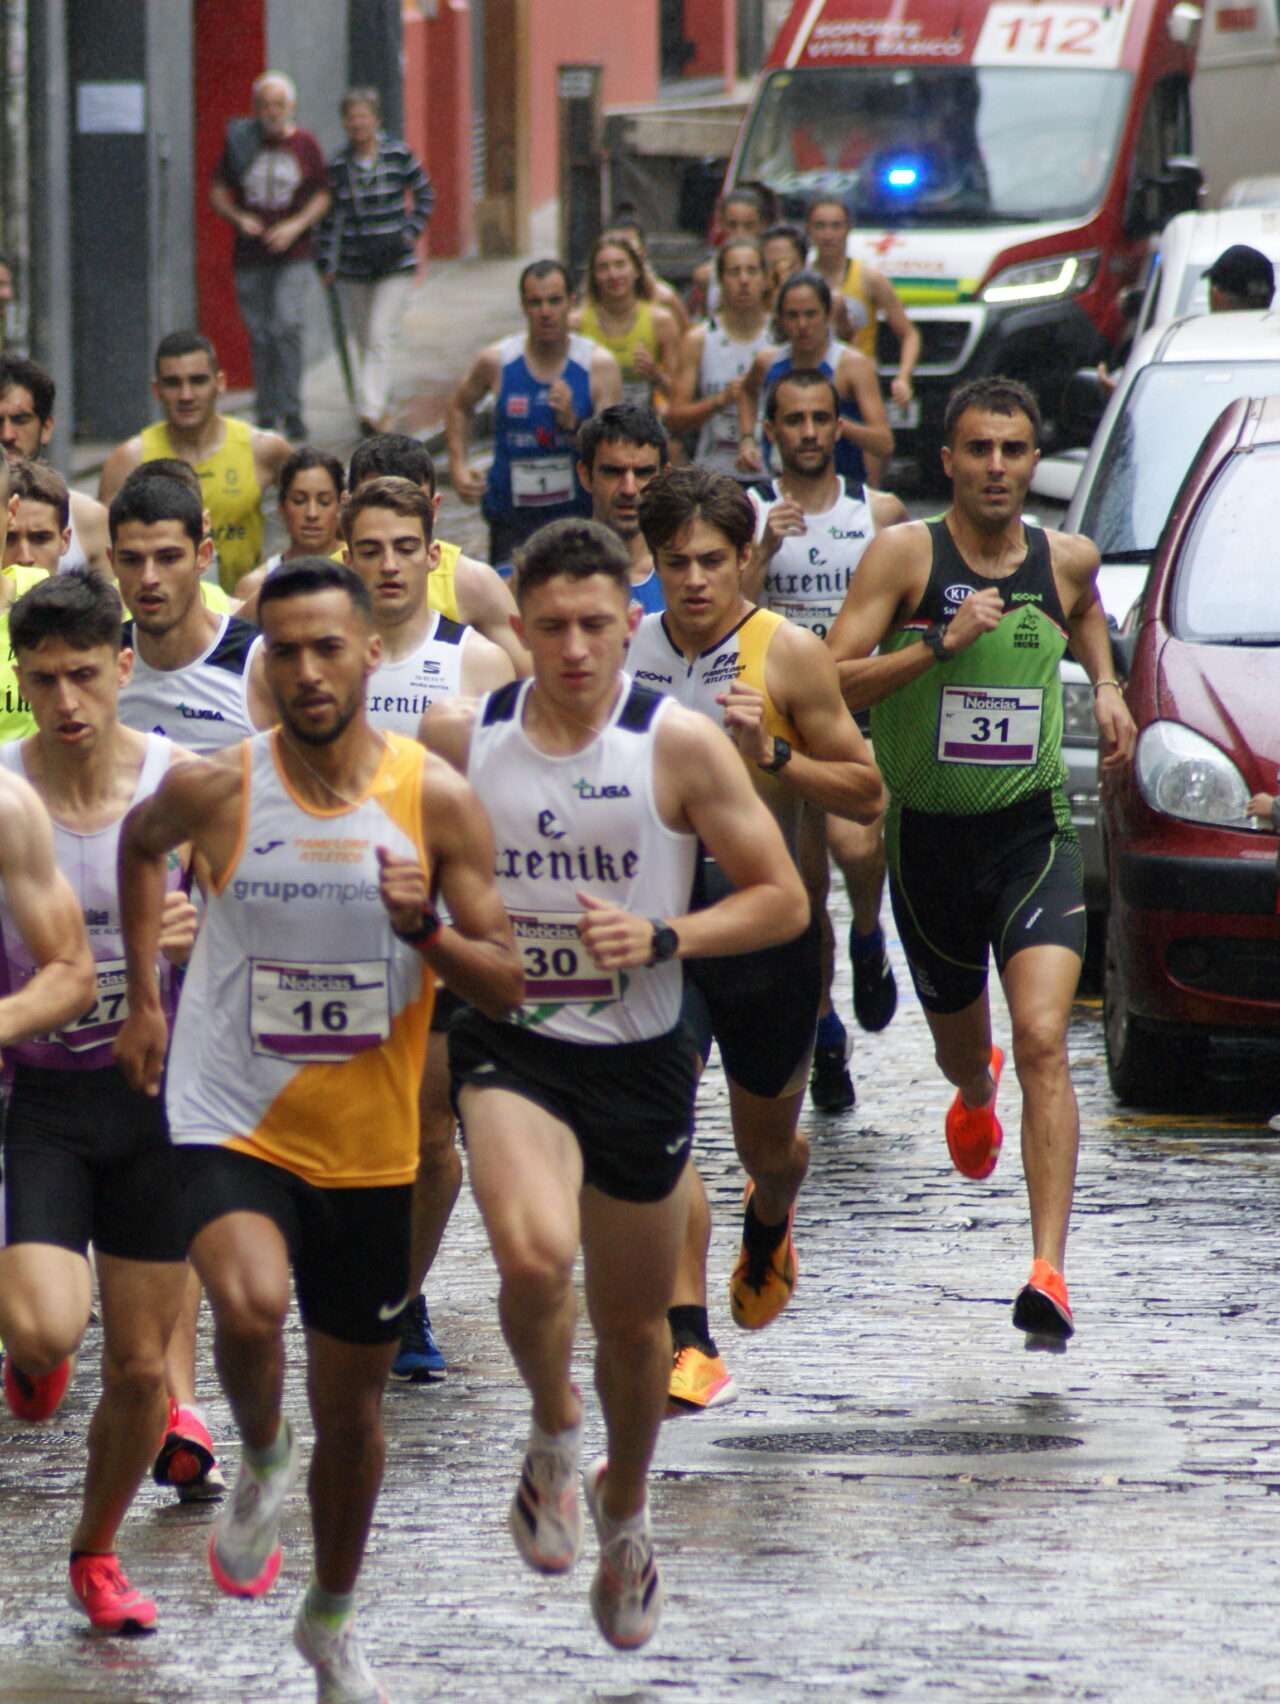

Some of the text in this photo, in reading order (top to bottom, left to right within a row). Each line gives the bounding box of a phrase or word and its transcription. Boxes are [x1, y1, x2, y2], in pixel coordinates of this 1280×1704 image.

[813, 20, 924, 39] SOPORTE
[1001, 16, 1100, 54] 112
[807, 41, 869, 58] VITAL
[713, 652, 739, 669] PA
[966, 697, 1016, 710] Noticias
[971, 717, 1009, 742] 31
[293, 839, 370, 849] PAMPLONA
[513, 922, 578, 938] Noticias
[523, 947, 578, 977] 30
[281, 975, 351, 990] Noticias
[77, 993, 125, 1026] 27
[293, 1001, 348, 1032] 16
